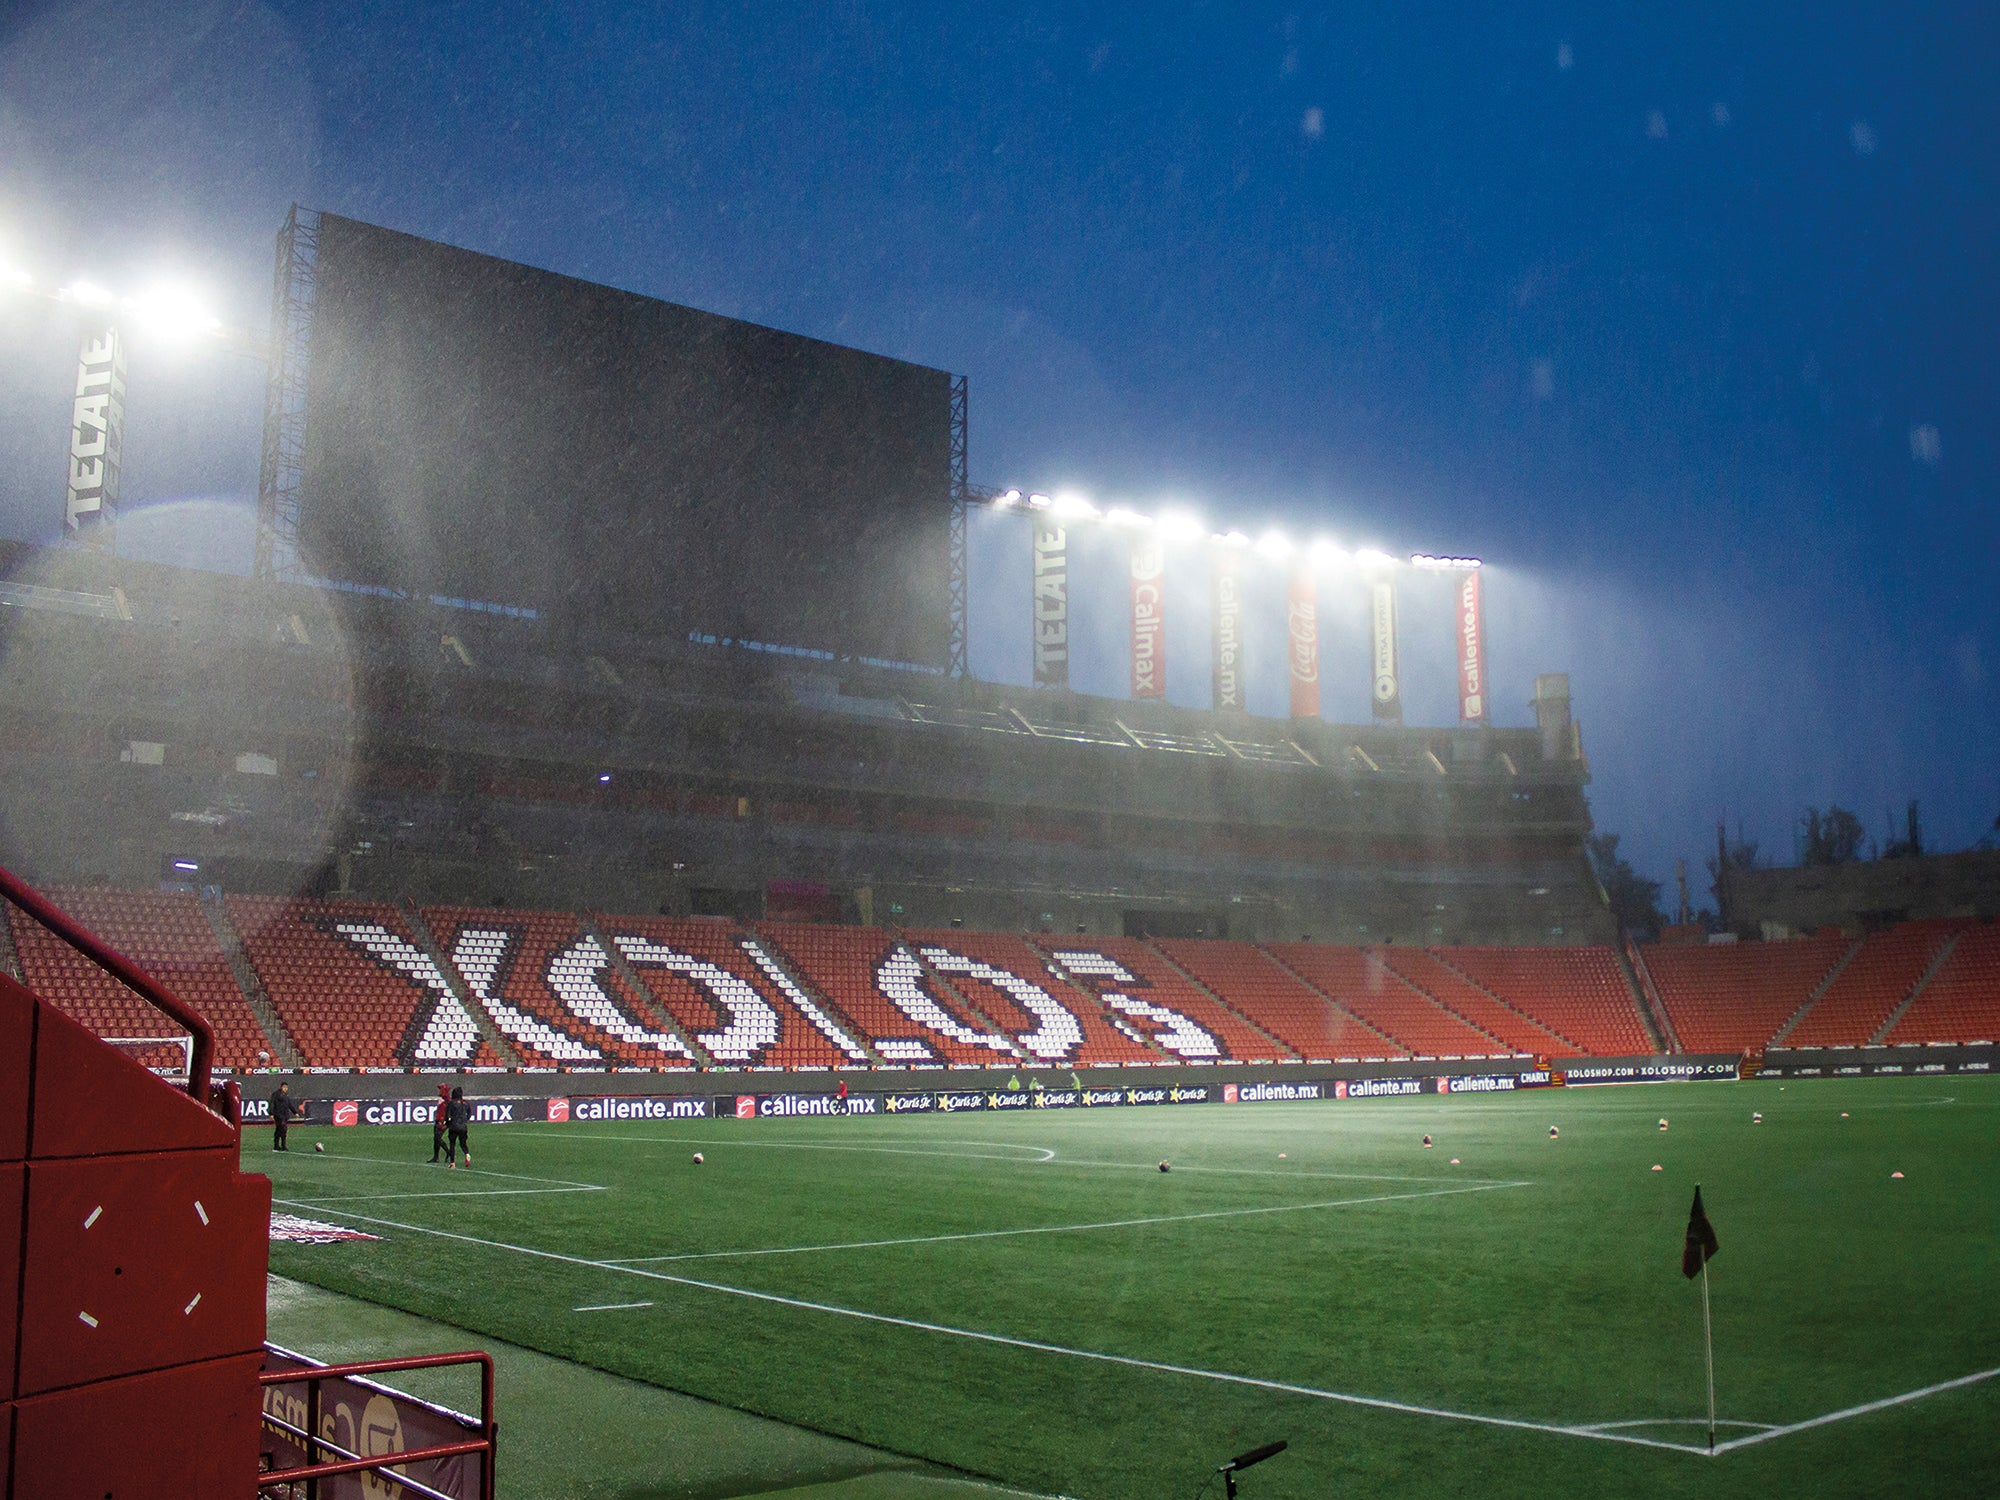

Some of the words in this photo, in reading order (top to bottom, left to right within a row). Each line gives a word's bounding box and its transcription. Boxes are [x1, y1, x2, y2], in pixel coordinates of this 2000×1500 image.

[66, 327, 114, 530] TECATE
[1034, 526, 1067, 675] TECATE
[1135, 583, 1160, 692] Calimax
[1219, 575, 1239, 707] caliente.mx
[336, 924, 1220, 1060] XOLOS
[1520, 1072, 1550, 1084] CHARLY
[1567, 1067, 1634, 1078] XOLOSHOP.COM
[1640, 1064, 1734, 1076] XOLOSHOP.COM
[1240, 1084, 1319, 1100] caliente.mx
[1348, 1080, 1421, 1097] caliente.mx
[1450, 1077, 1515, 1093] caliente.mx
[575, 1099, 706, 1120] caliente.mx
